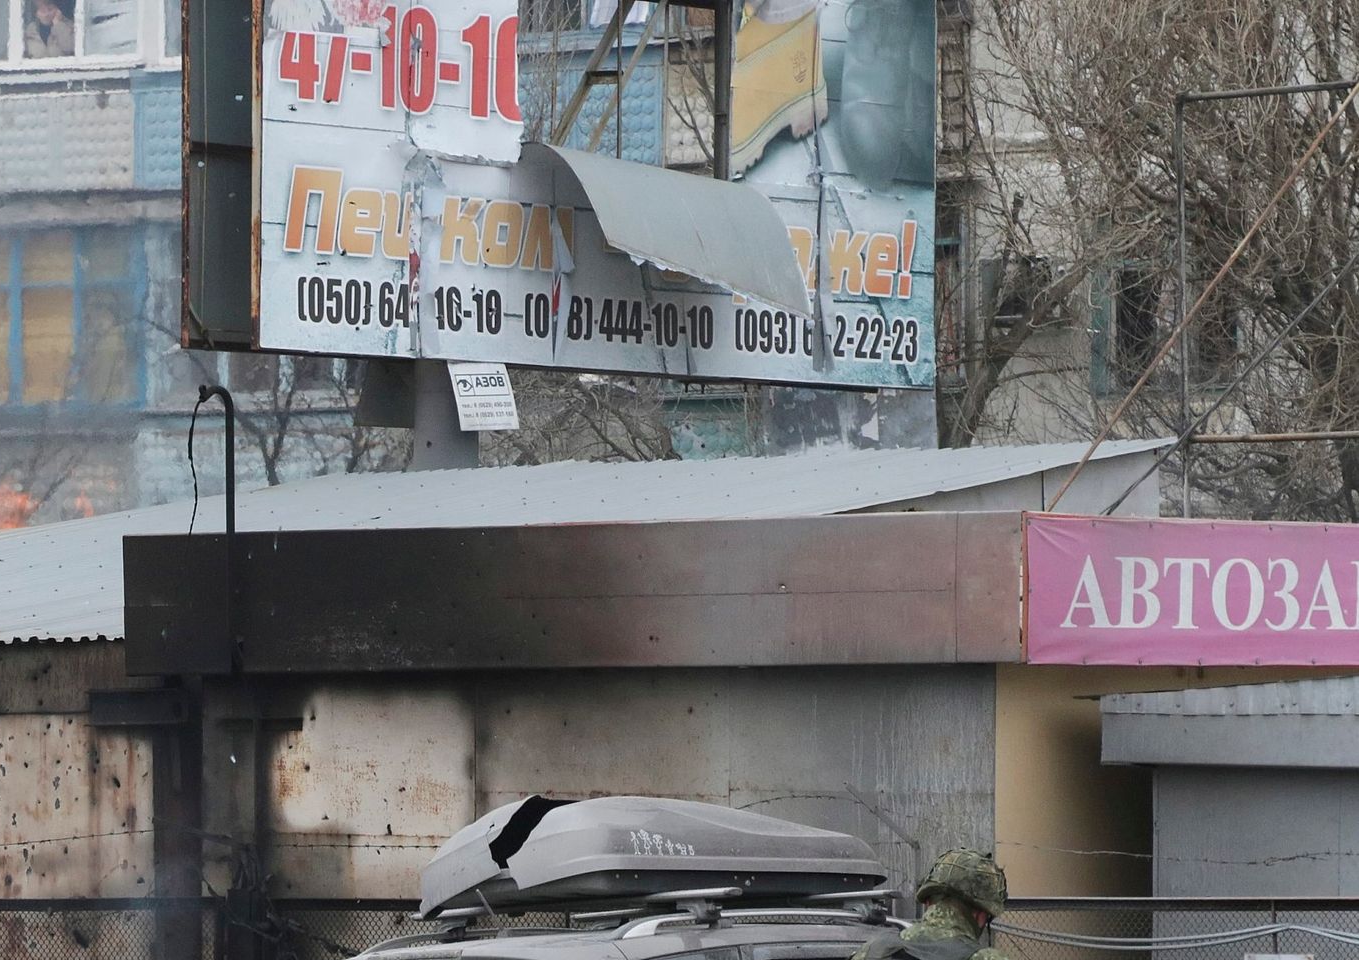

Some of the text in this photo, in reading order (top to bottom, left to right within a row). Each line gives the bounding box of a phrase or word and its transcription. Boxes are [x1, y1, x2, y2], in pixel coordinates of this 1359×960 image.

[524, 292, 593, 341] (08)
[475, 376, 505, 388] АЗОВ
[1059, 554, 1359, 632] АВТОЗА
